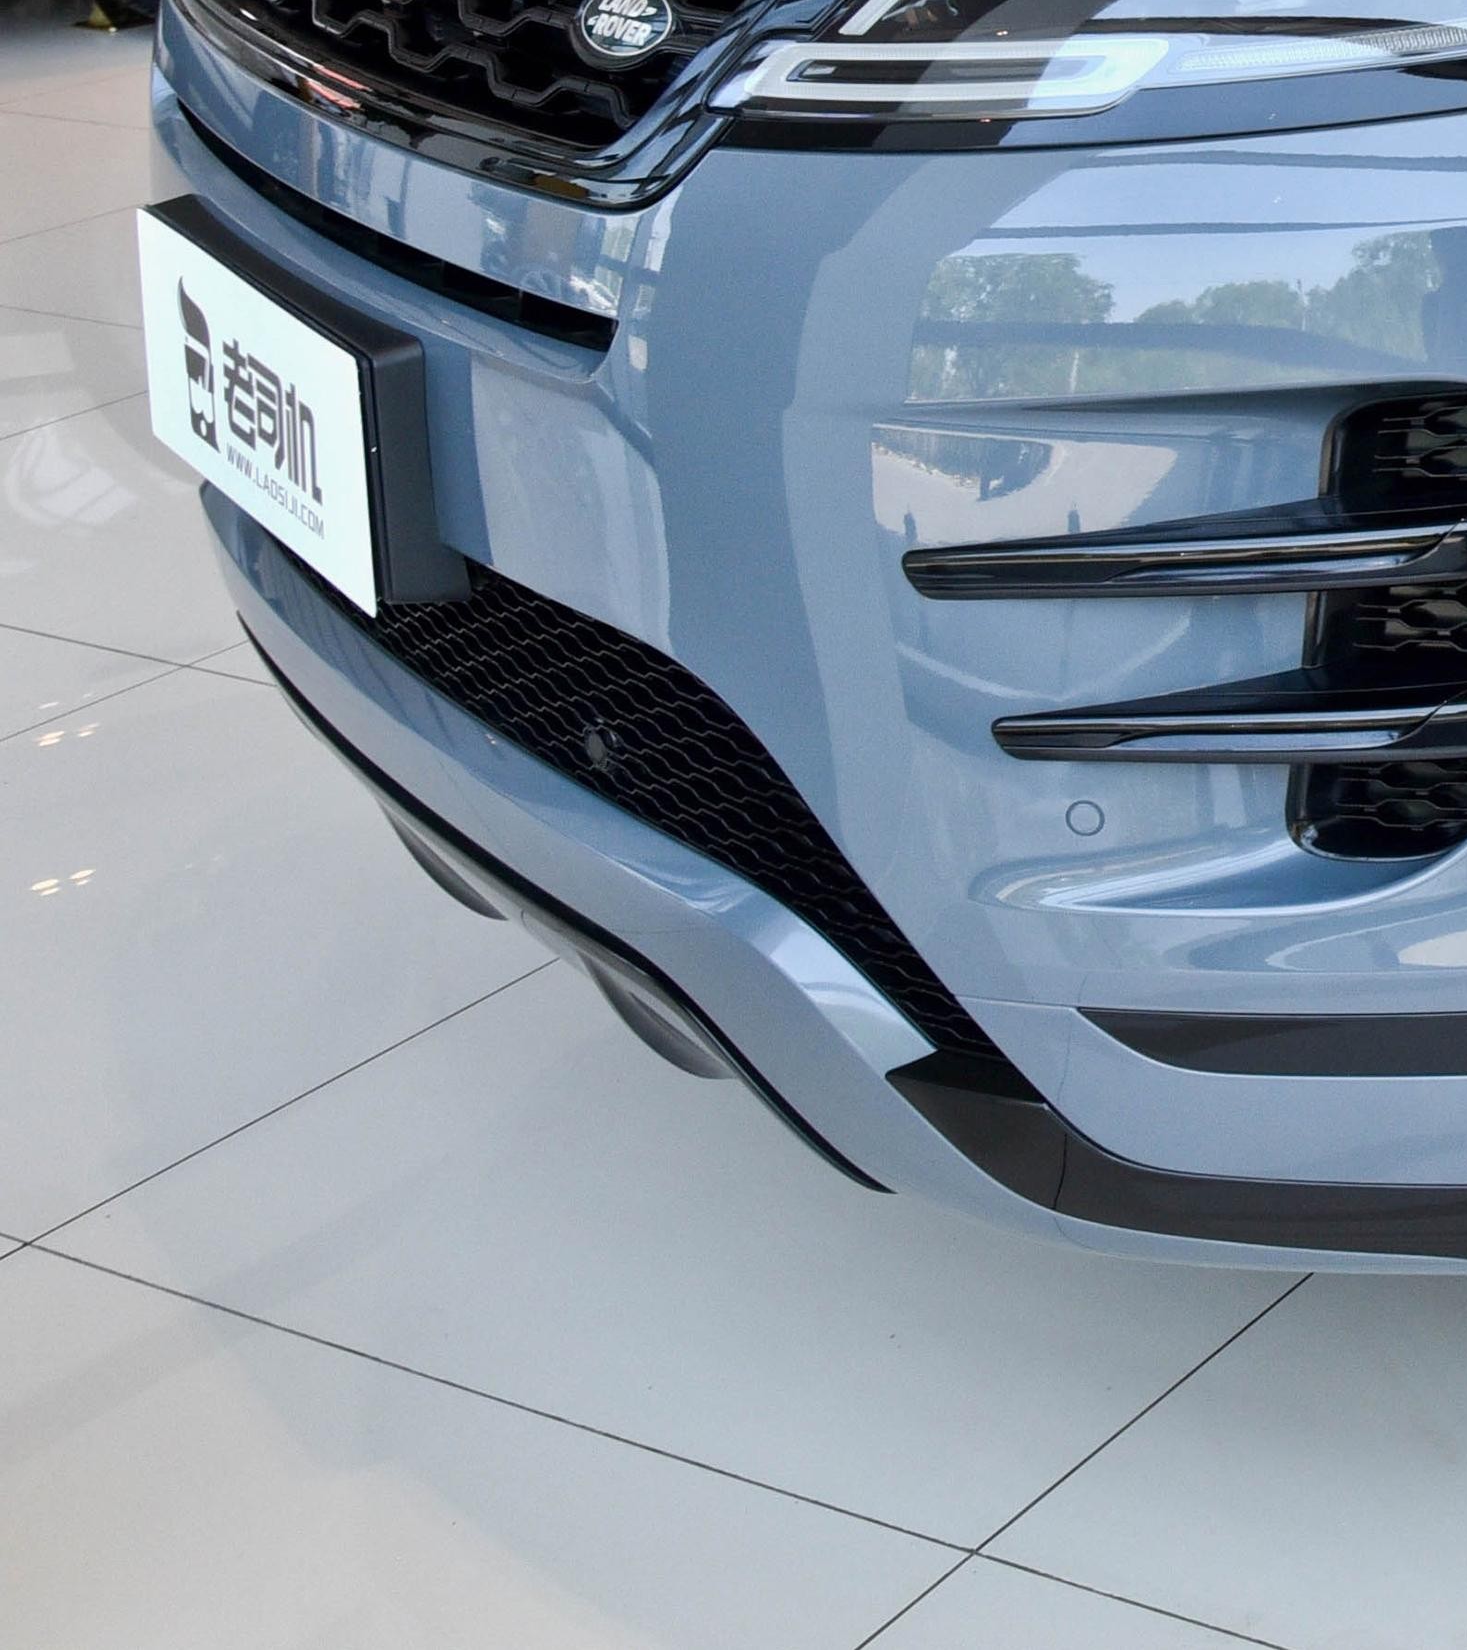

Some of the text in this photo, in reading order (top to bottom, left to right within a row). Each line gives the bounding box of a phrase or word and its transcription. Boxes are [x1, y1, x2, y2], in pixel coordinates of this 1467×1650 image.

[591, 13, 652, 46] ROVER
[222, 338, 323, 505] 老司机
[226, 442, 325, 540] WWW.LAOSIJI.COM
